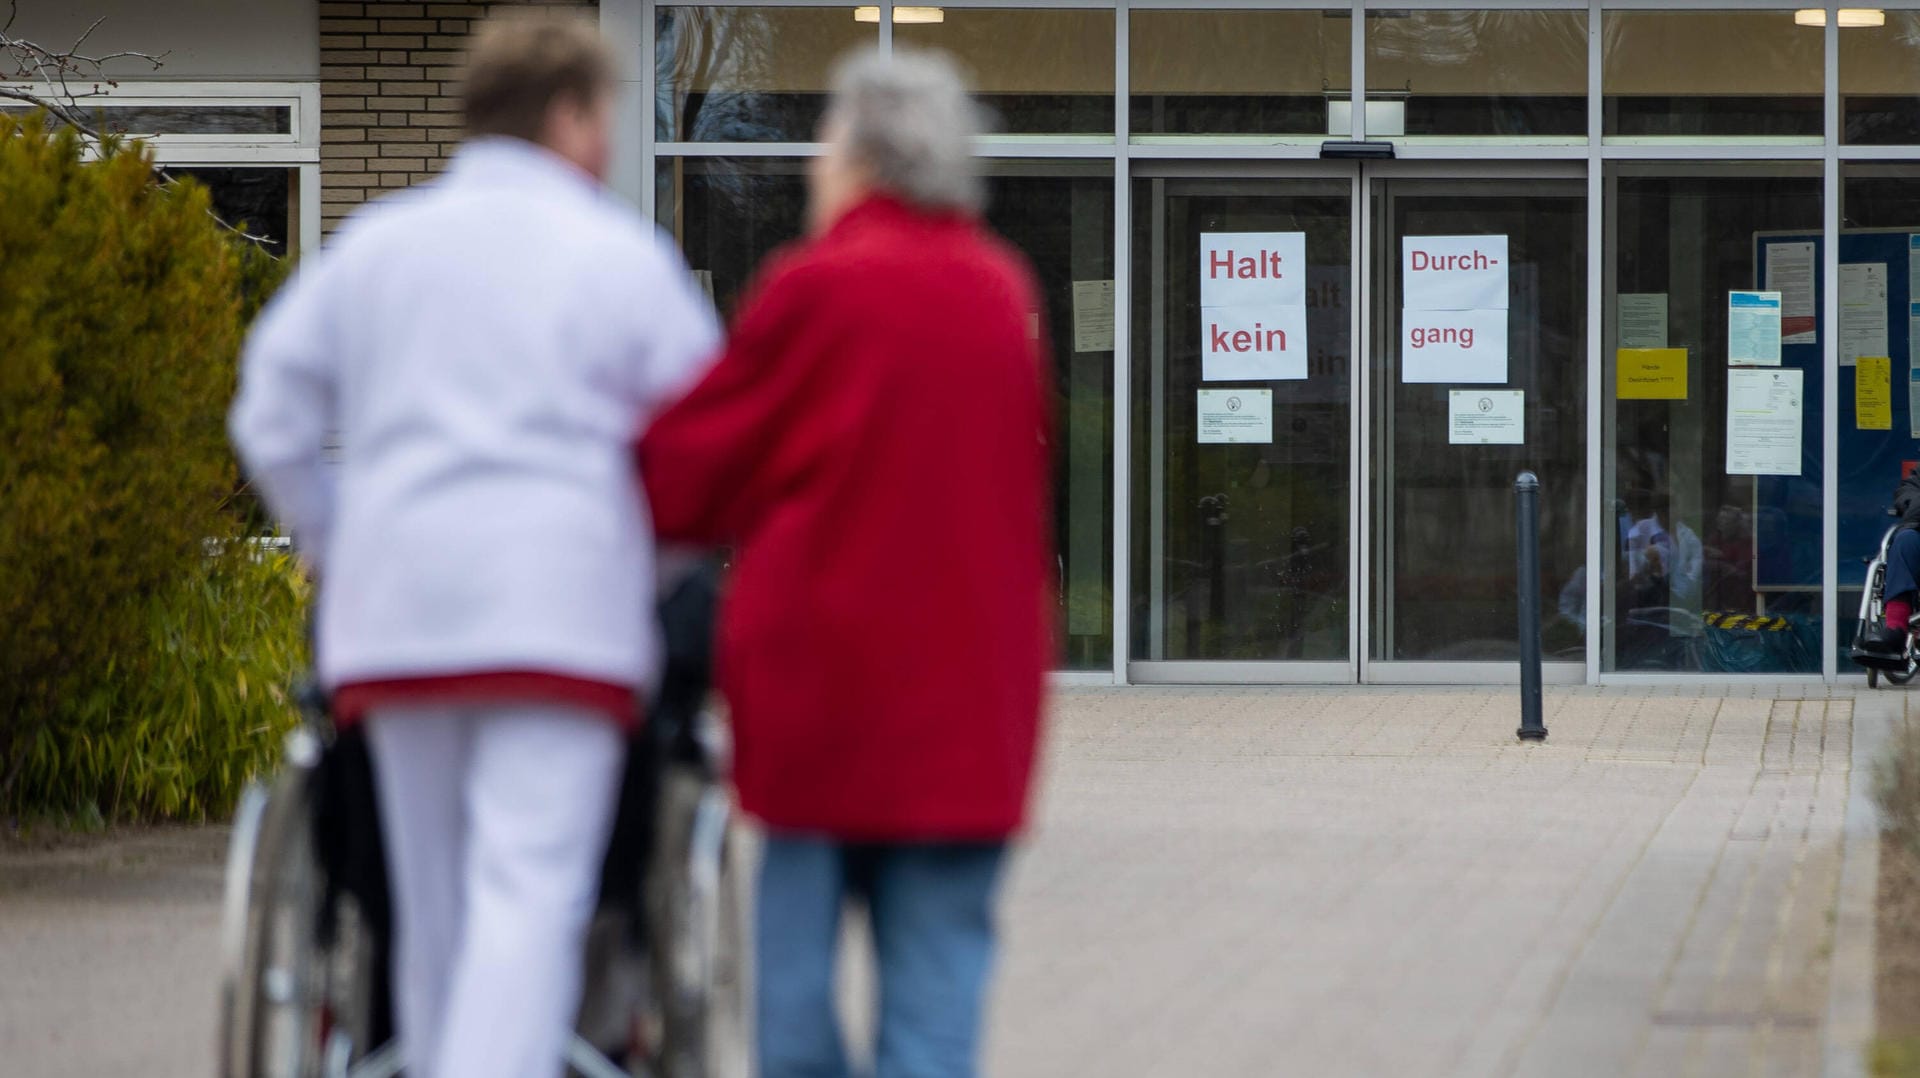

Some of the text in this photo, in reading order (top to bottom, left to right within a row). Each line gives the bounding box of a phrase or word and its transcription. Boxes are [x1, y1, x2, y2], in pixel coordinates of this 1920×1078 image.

[1210, 250, 1282, 279] Halt
[1411, 250, 1498, 271] Durch-
[1306, 280, 1341, 308] alt
[1210, 323, 1287, 353] kein
[1410, 327, 1474, 349] gang
